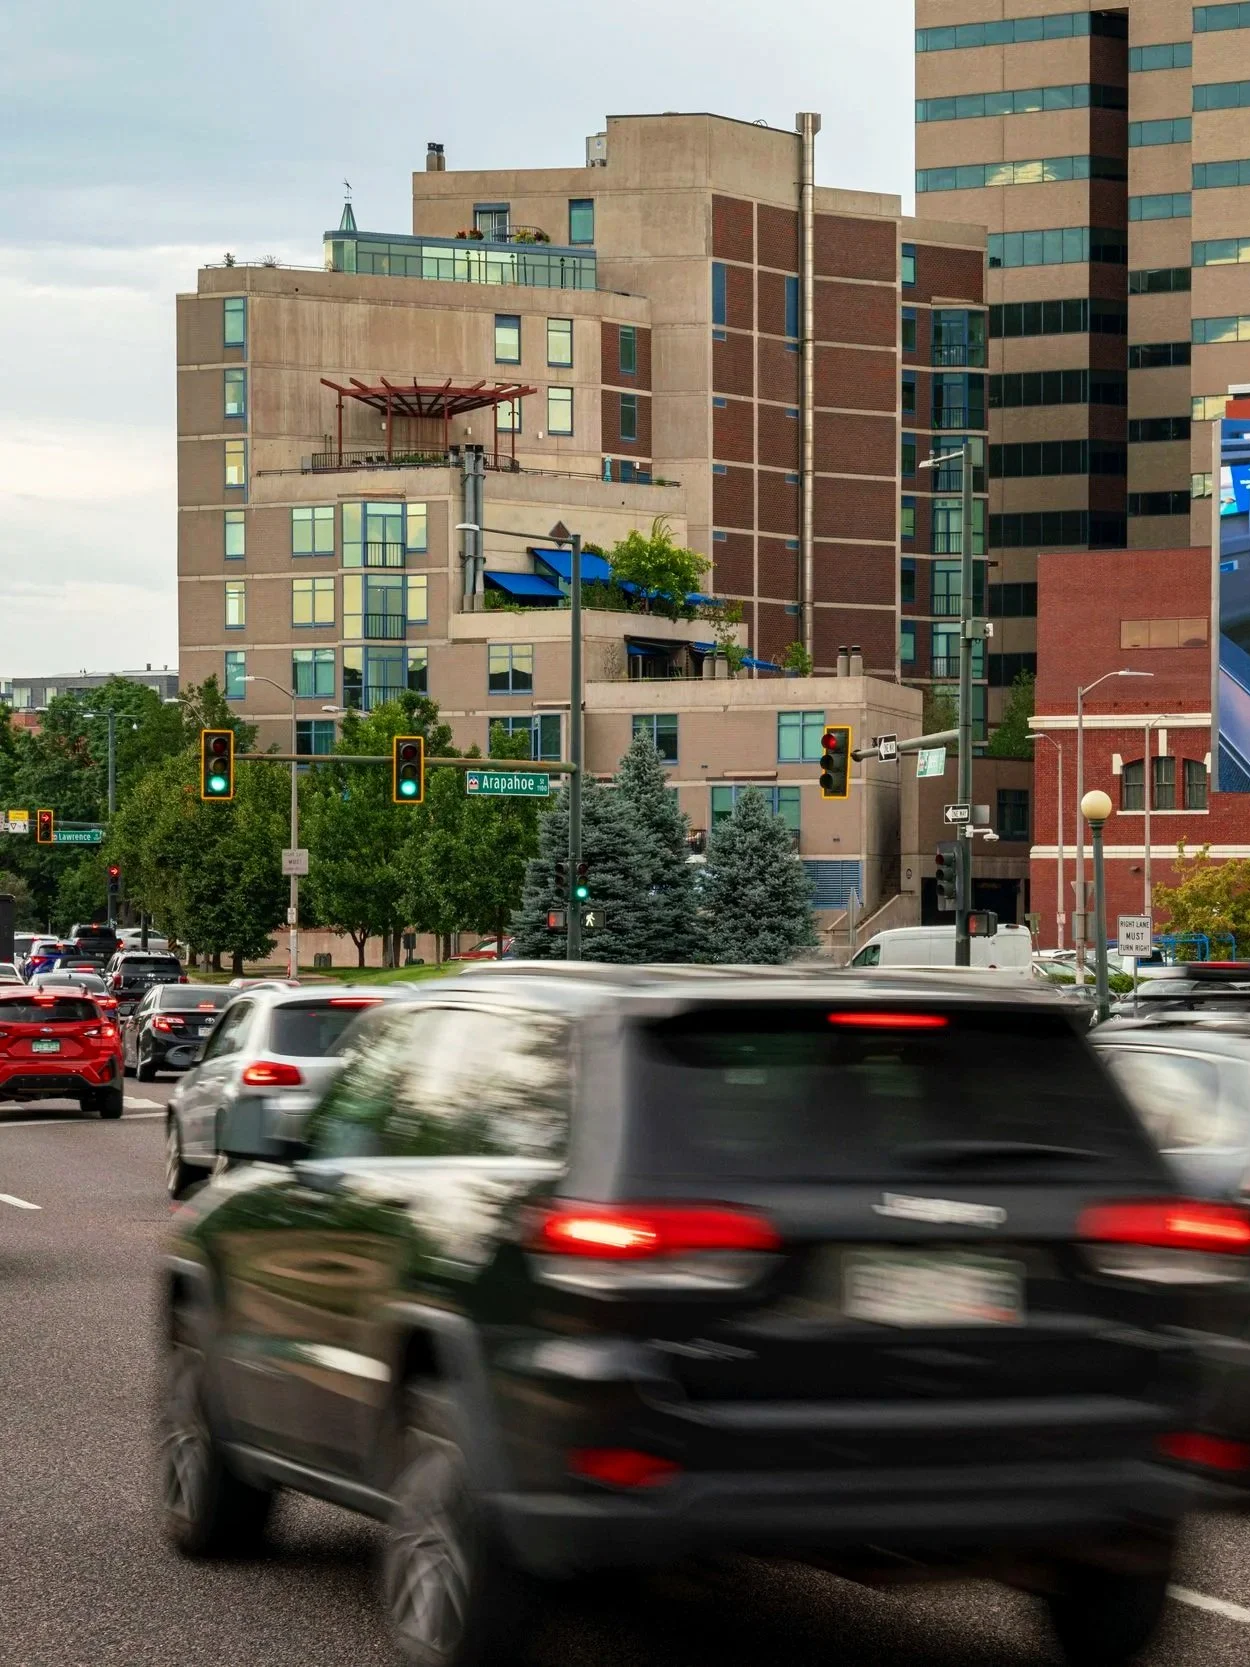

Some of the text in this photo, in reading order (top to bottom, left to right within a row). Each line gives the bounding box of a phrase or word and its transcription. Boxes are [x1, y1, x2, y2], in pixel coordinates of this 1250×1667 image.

[482, 775, 534, 793] Arapahoe
[58, 832, 91, 841] Lawrence
[1120, 920, 1135, 928] RIGHT
[1126, 932, 1144, 941] MUST
[1135, 944, 1150, 952] RIGHT
